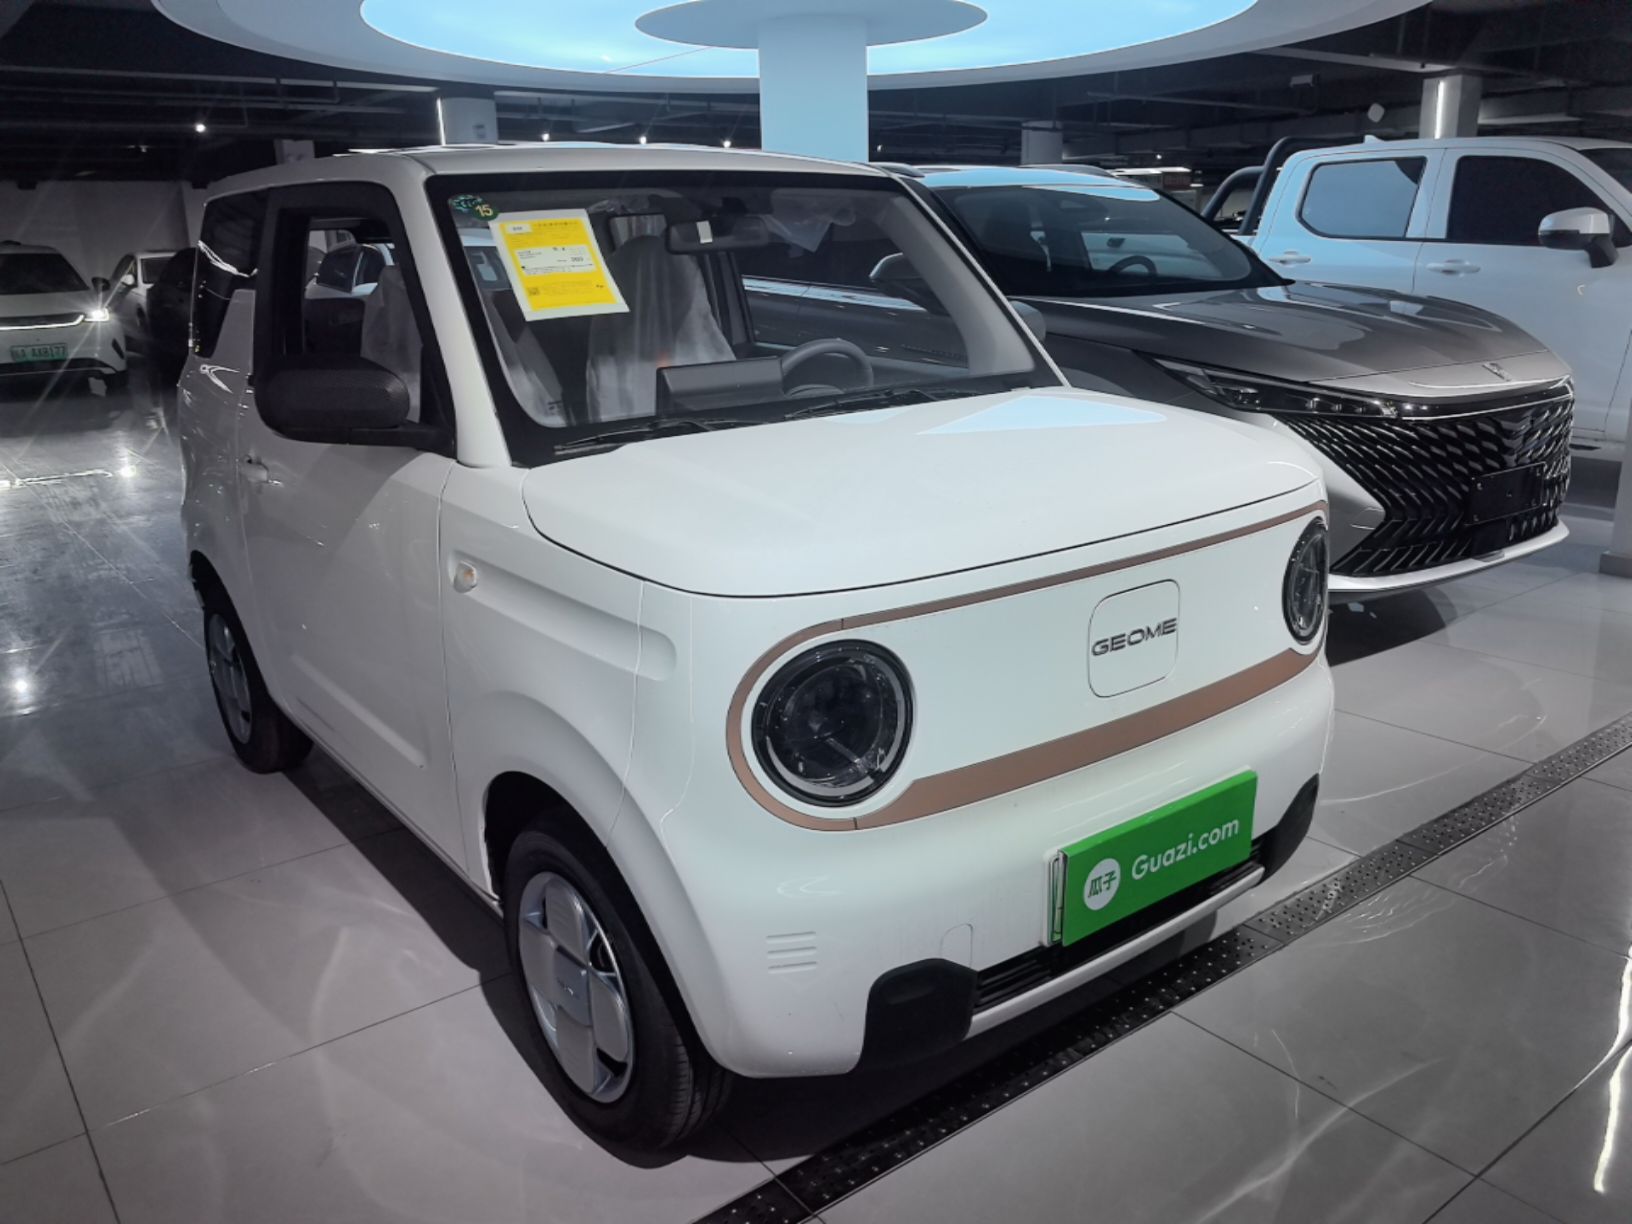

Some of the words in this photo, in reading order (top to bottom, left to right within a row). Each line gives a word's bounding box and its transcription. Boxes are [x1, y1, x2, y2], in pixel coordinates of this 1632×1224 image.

[475, 204, 493, 217] 15
[1092, 617, 1177, 656] GEOME
[1087, 870, 1117, 898] 瓜子
[1131, 819, 1240, 880] Guazi.com
